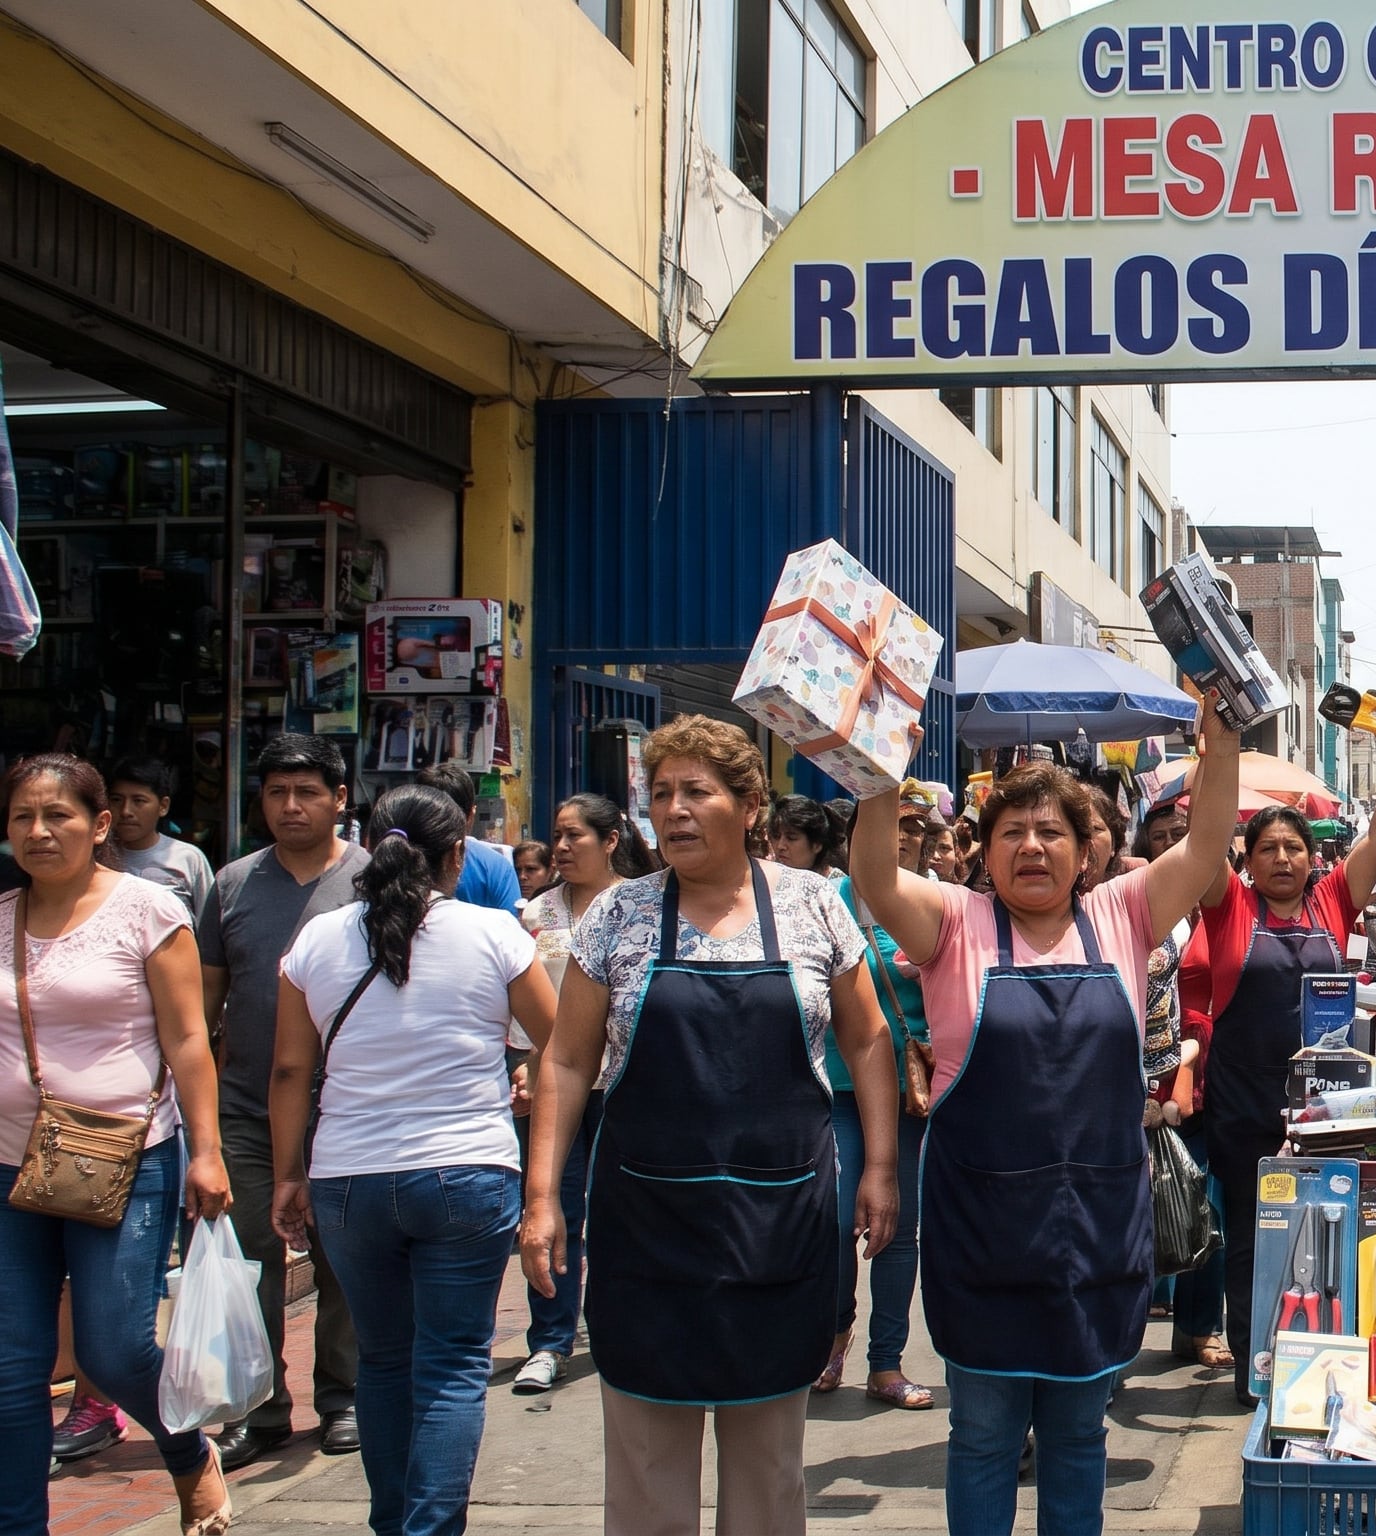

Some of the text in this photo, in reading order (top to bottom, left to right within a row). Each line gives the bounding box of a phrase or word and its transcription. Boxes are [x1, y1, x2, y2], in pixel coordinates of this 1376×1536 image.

[1082, 21, 1344, 91] CENTRO
[1016, 114, 1298, 218] MESA
[794, 253, 1250, 359] REGALOS
